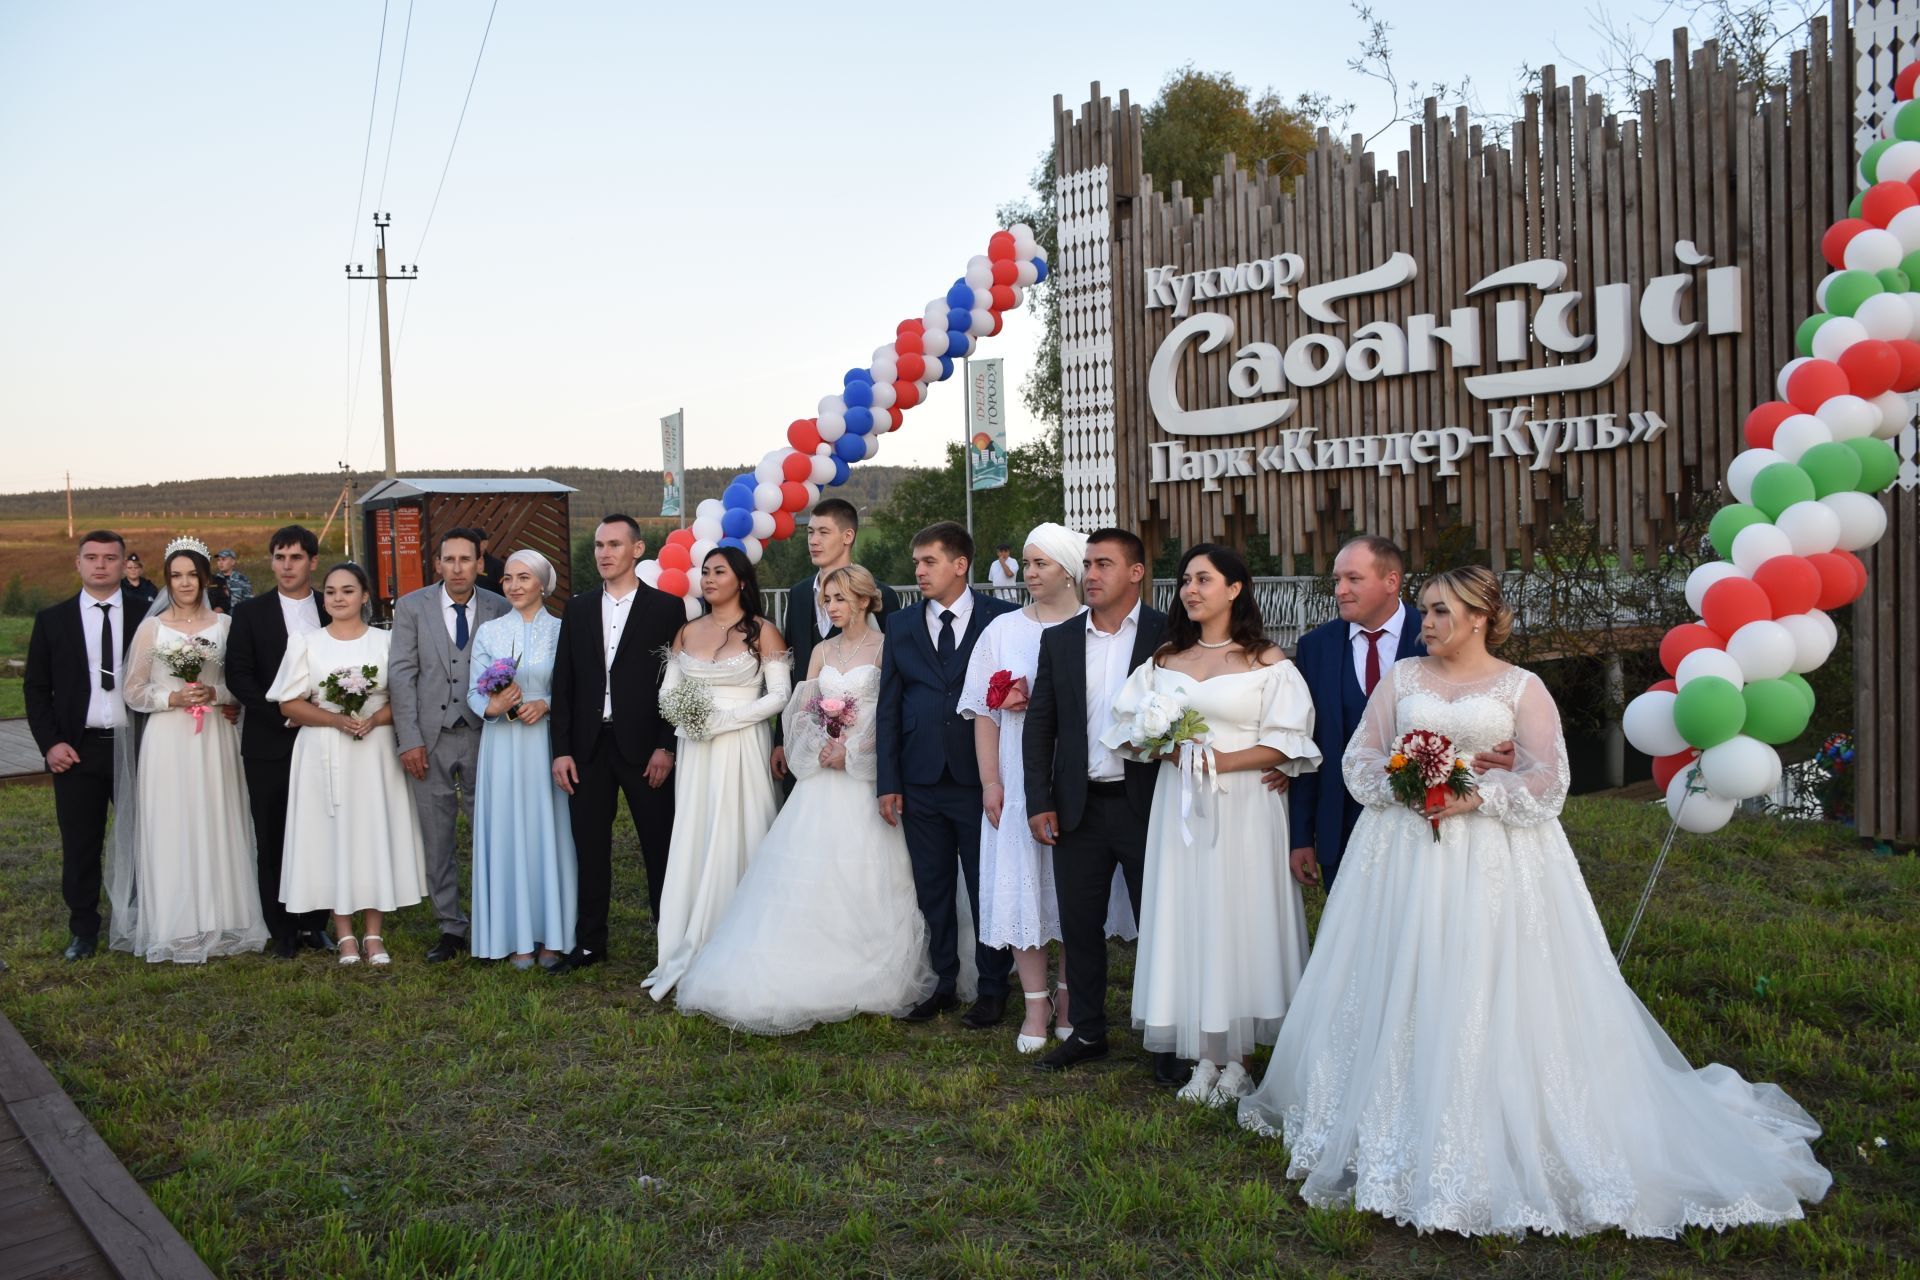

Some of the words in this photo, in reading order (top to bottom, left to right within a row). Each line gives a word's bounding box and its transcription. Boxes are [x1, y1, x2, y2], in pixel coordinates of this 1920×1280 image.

[1144, 252, 1305, 318] Кукмор
[1148, 239, 1743, 435] Сабантуй
[975, 374, 985, 421] ДЕНЬ
[986, 363, 998, 425] ГОРОДА
[1149, 440, 1256, 492] Парк
[1257, 405, 1668, 477] «Киндер-Куль»
